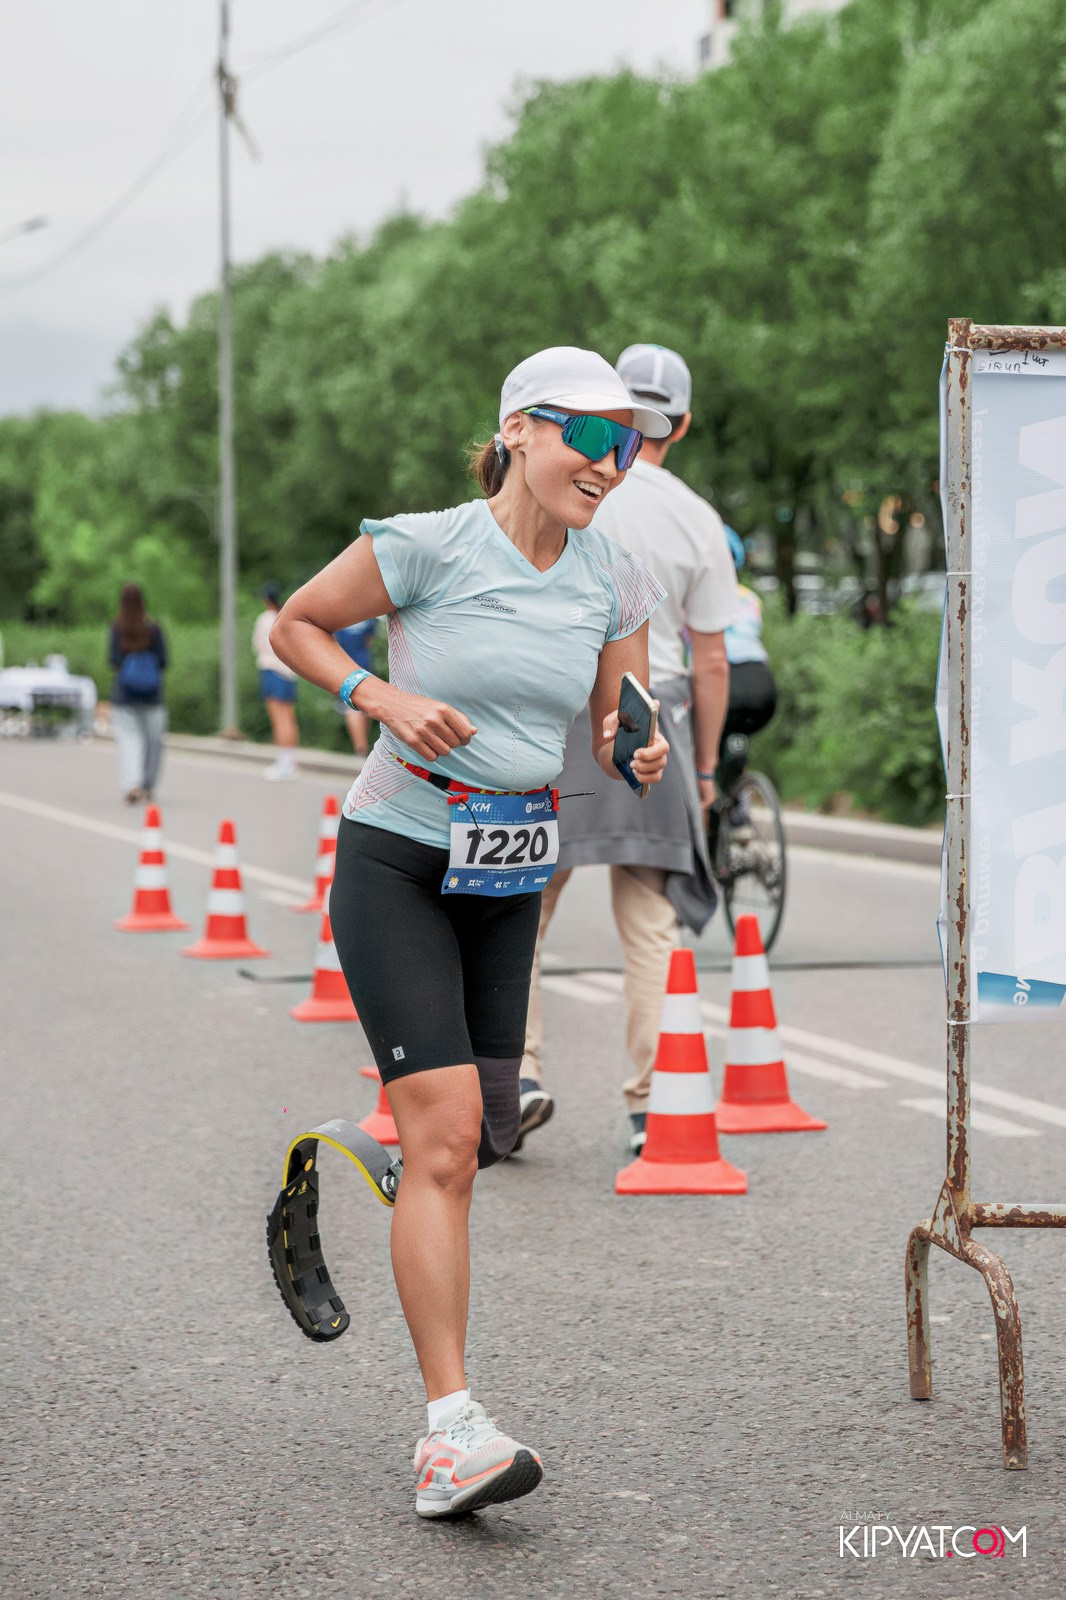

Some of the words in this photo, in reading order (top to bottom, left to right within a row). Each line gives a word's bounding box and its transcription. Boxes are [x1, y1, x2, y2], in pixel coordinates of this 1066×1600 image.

[473, 596, 499, 604] ALMATY
[481, 603, 517, 613] MARATHON
[470, 802, 491, 813] KM
[465, 826, 549, 865] 1220
